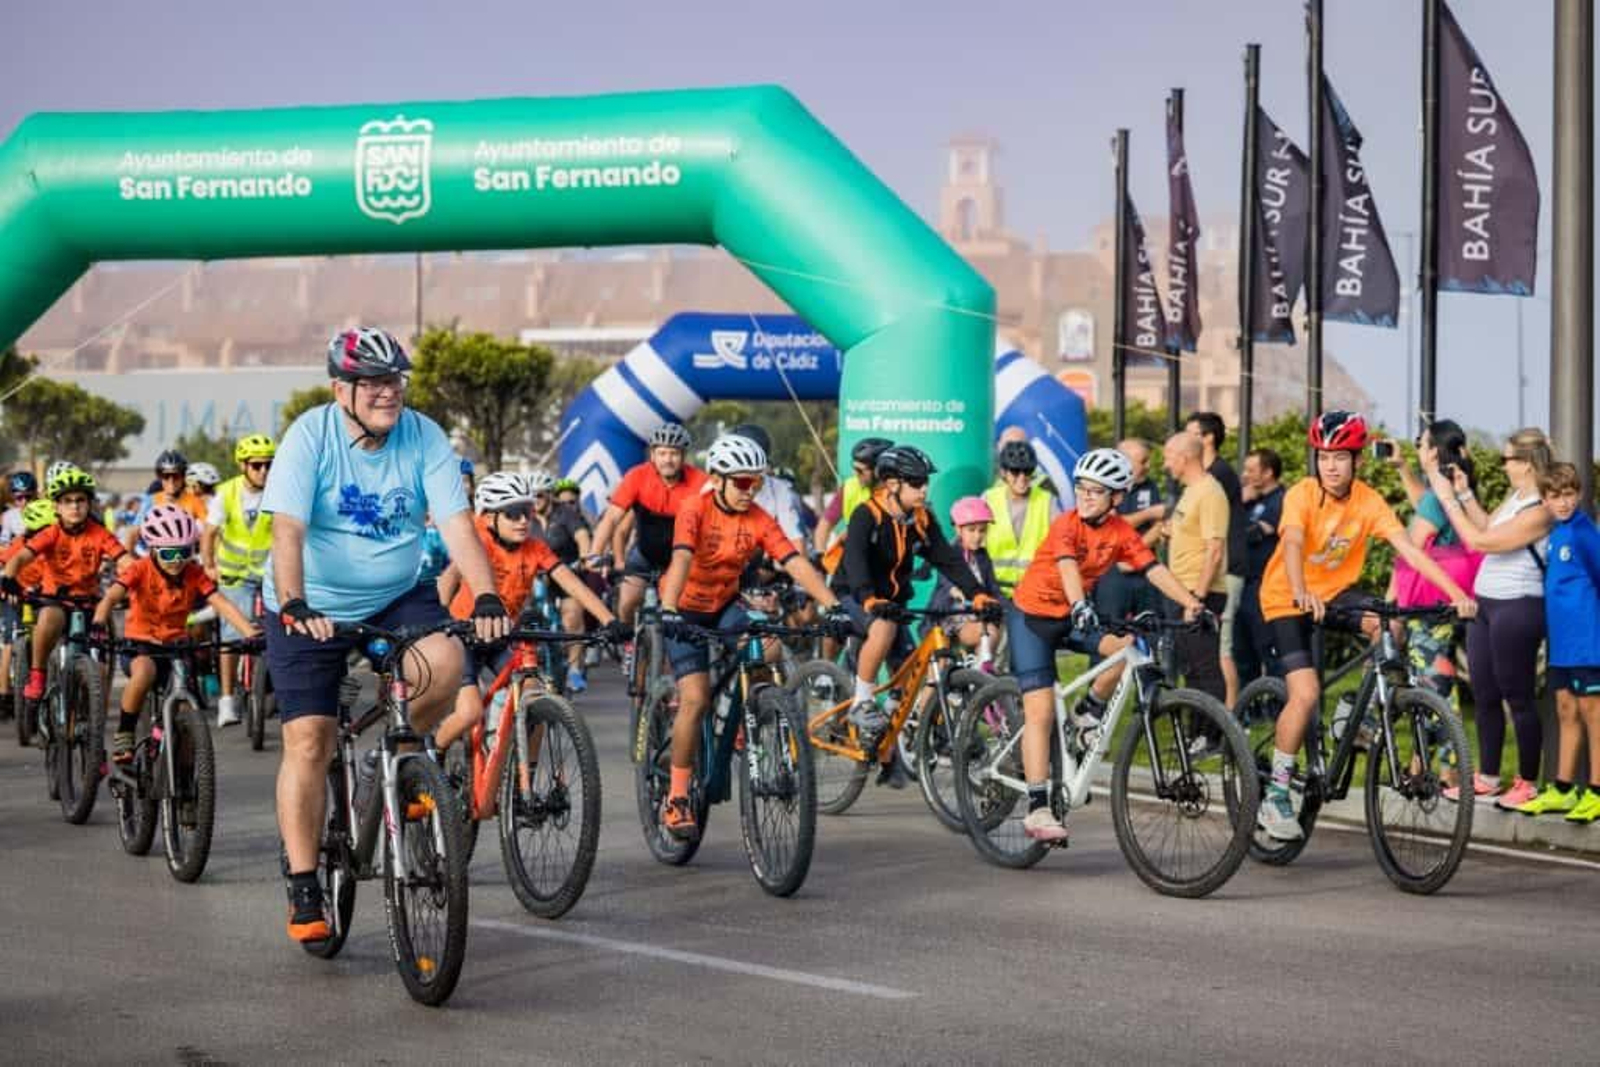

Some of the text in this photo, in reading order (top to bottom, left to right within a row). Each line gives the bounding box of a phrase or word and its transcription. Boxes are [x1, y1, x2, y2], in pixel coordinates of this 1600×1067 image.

[119, 145, 313, 173] Ayuntamiento de
[366, 145, 420, 165] SAN
[474, 133, 682, 165] Ayuntamiento de
[119, 172, 313, 200] San Fernando
[474, 160, 682, 191] San Fernando
[1457, 144, 1497, 261] BAHÍA
[1335, 192, 1371, 297] BAHÍA
[753, 331, 831, 350] Diputació
[752, 350, 819, 370] de Cádiz
[872, 415, 965, 432] Fernando
